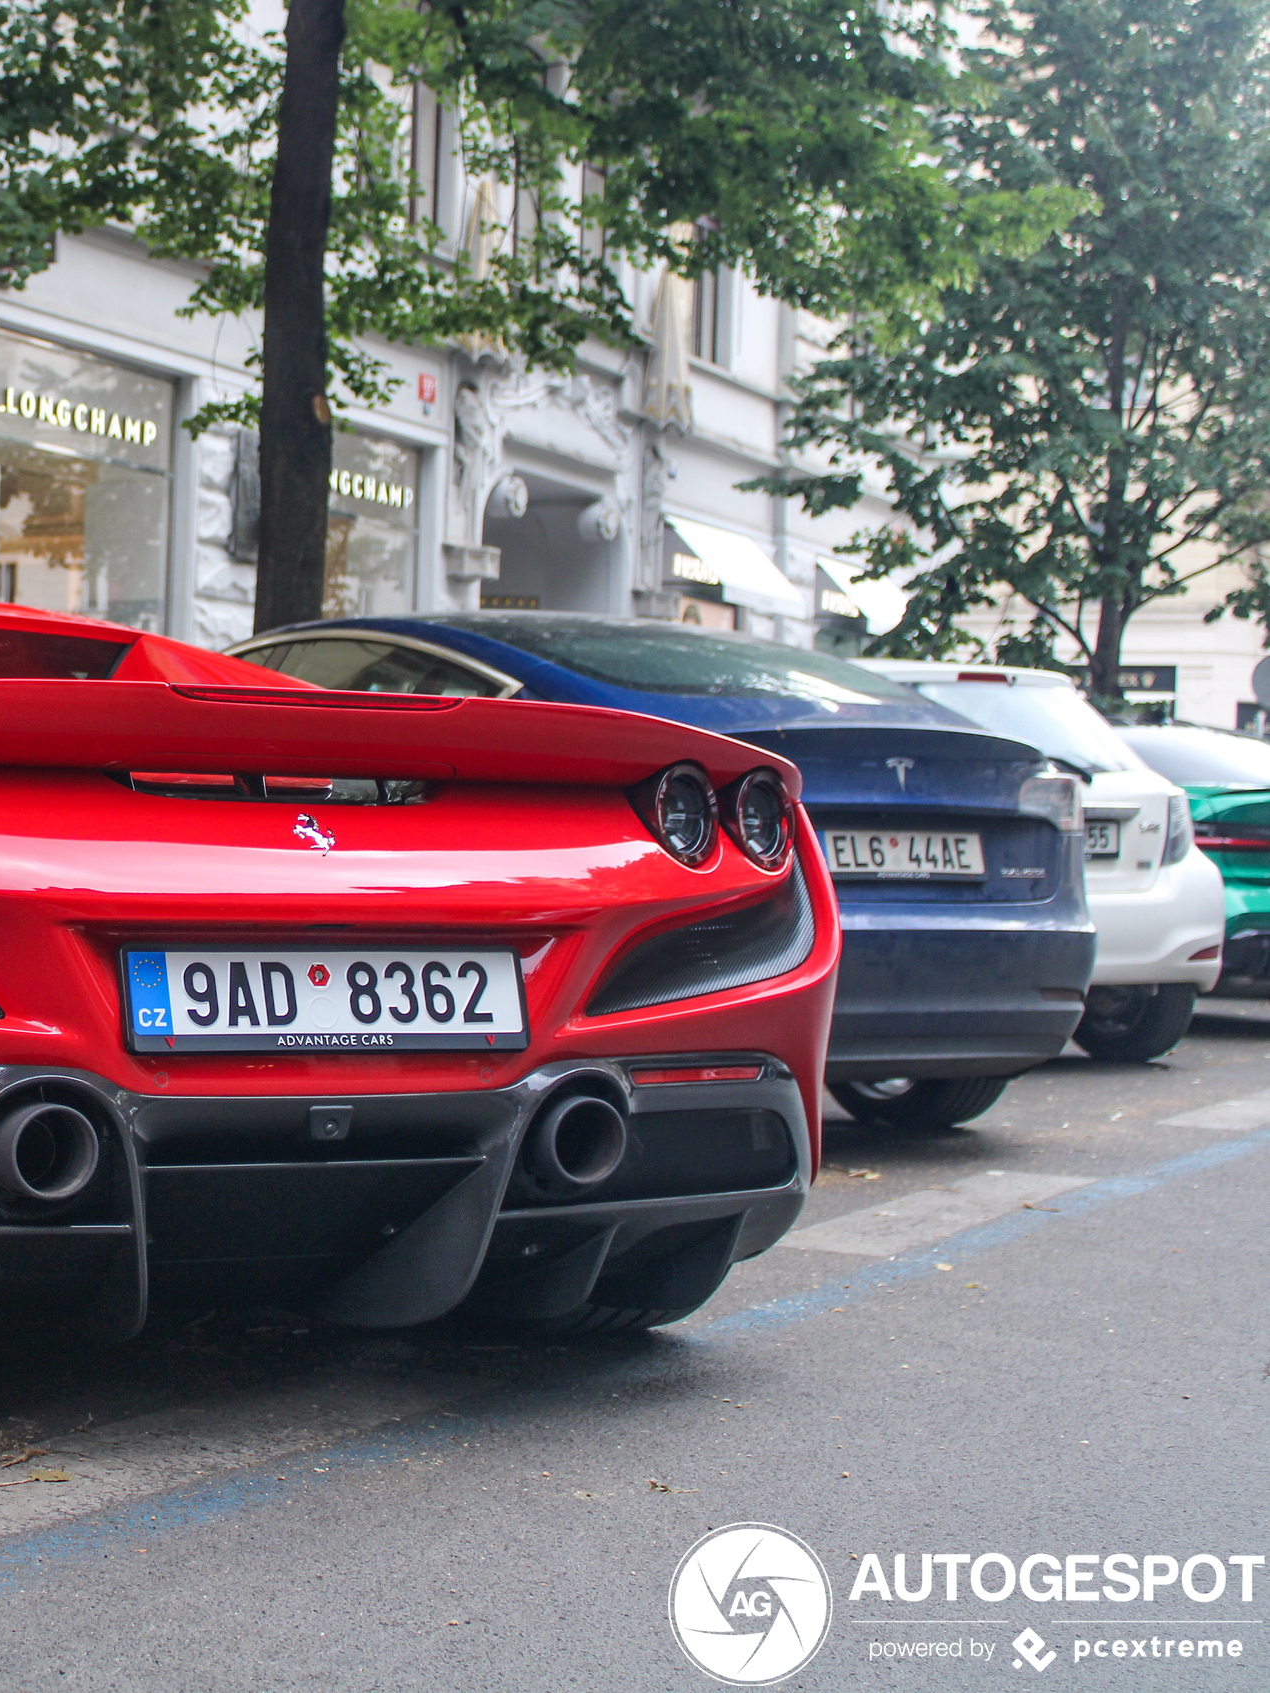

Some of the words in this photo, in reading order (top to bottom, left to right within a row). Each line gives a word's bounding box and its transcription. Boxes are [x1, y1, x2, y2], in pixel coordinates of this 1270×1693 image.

[5, 386, 158, 447] LONGCHAMP
[832, 835, 885, 869] EL6
[908, 836, 972, 870] 44AE
[182, 961, 299, 1027] 9AD
[345, 960, 494, 1025] 8362
[138, 1008, 168, 1027] CZ
[277, 1035, 358, 1047] ADVANTAGE
[361, 1034, 394, 1046] CARS
